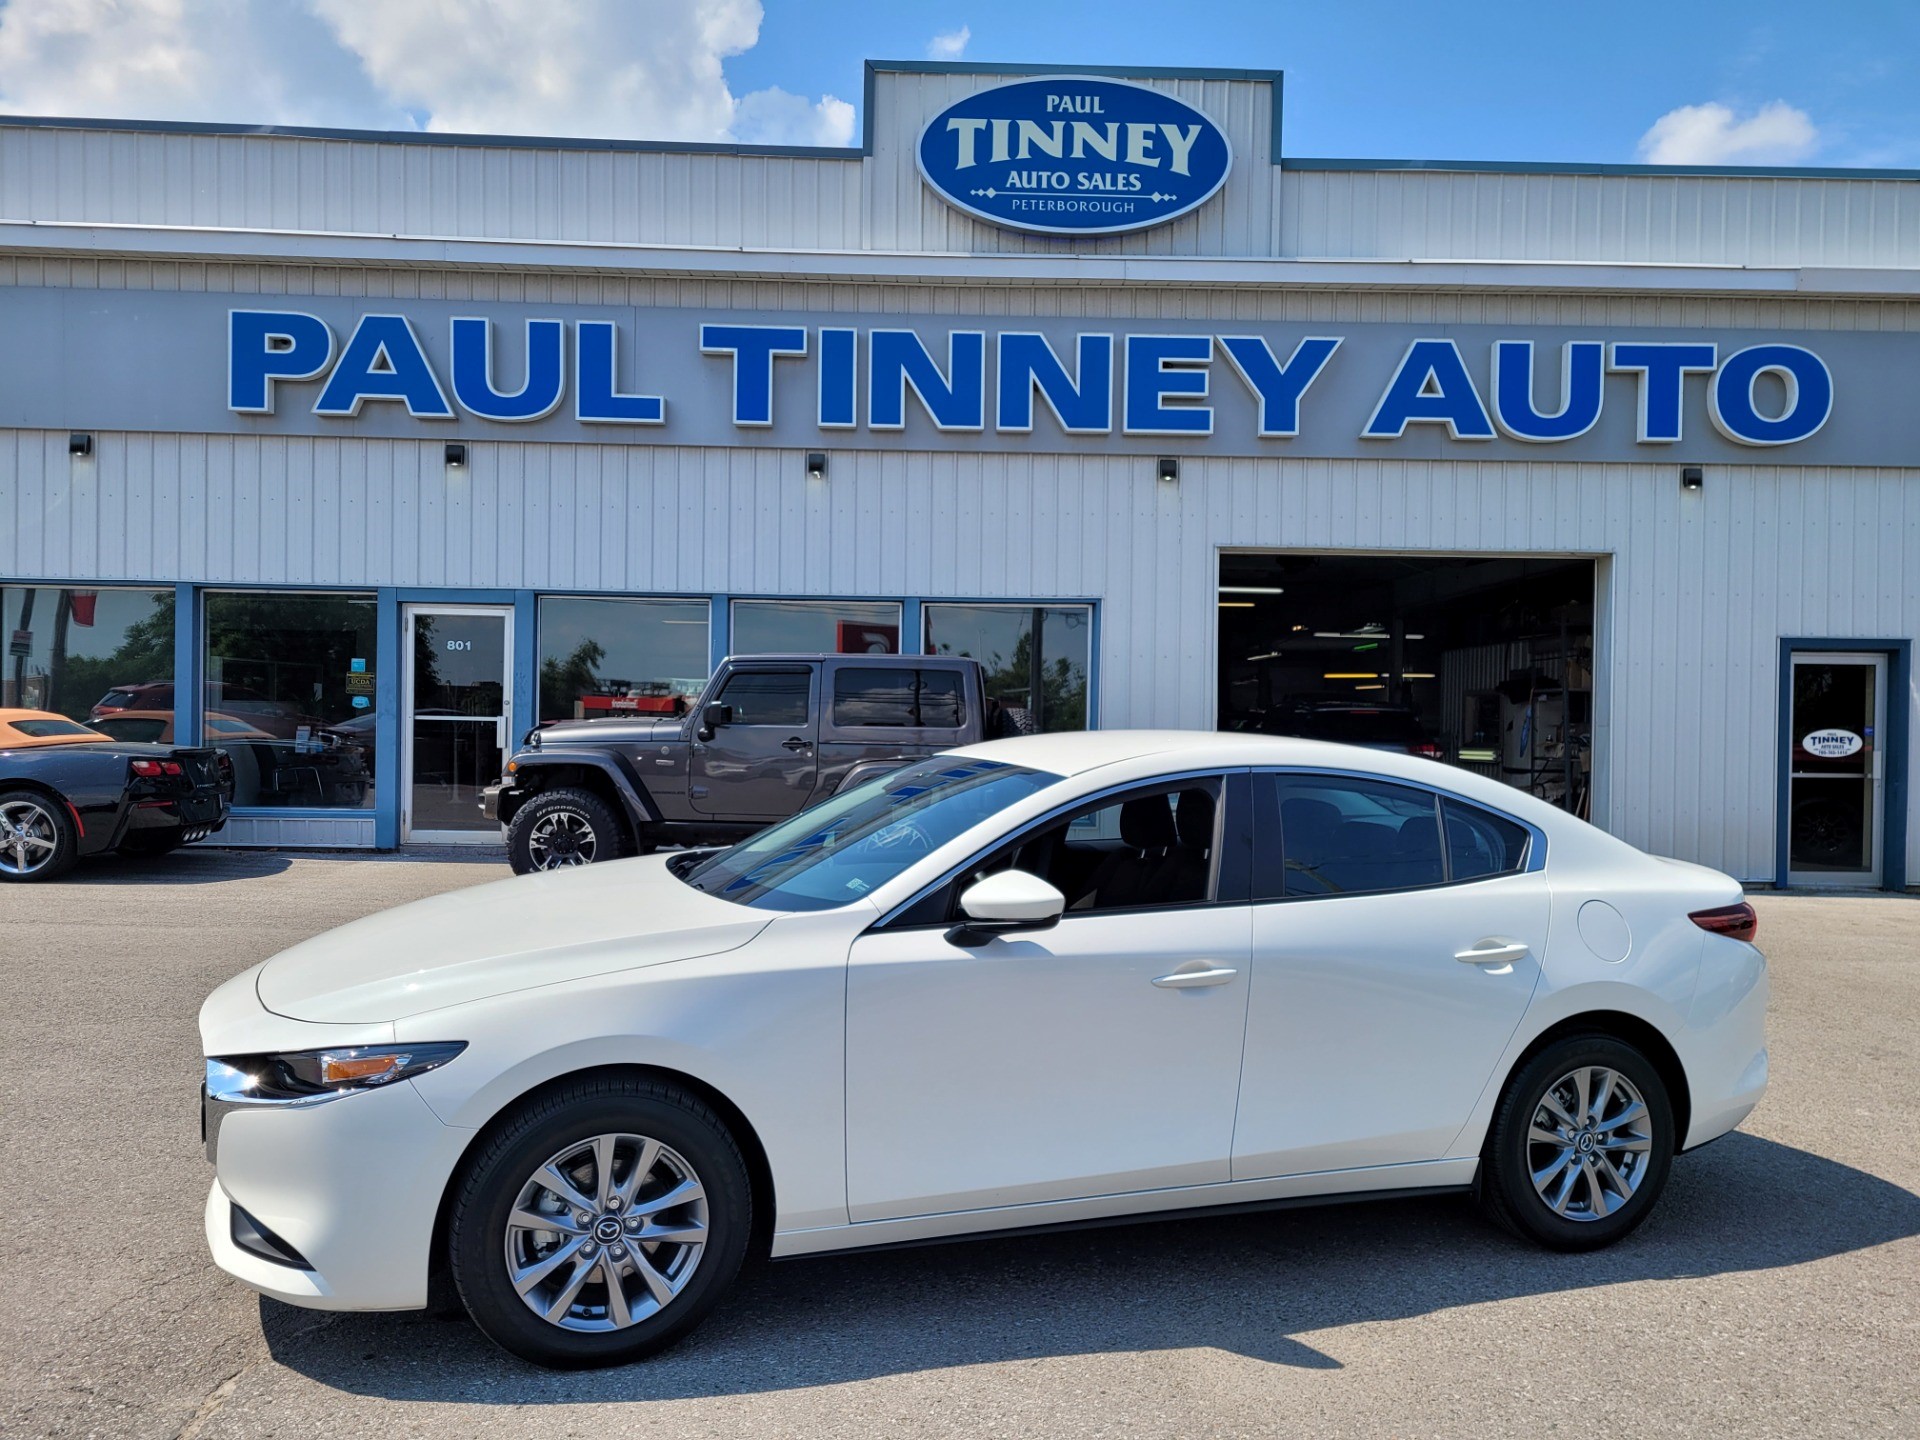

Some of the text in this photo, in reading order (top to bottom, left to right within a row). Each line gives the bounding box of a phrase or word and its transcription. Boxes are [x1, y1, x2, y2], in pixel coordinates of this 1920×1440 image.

[1046, 94, 1105, 113] PAUL
[946, 117, 1203, 177] TINNEY
[1005, 170, 1142, 191] AUTO SALES
[1012, 199, 1135, 213] PETERBOROUGH
[228, 309, 1833, 447] PAUL TINNEY AUTO
[447, 640, 471, 651] 801
[1810, 736, 1854, 747] TINNEY
[536, 805, 590, 818] BFGoodrich
